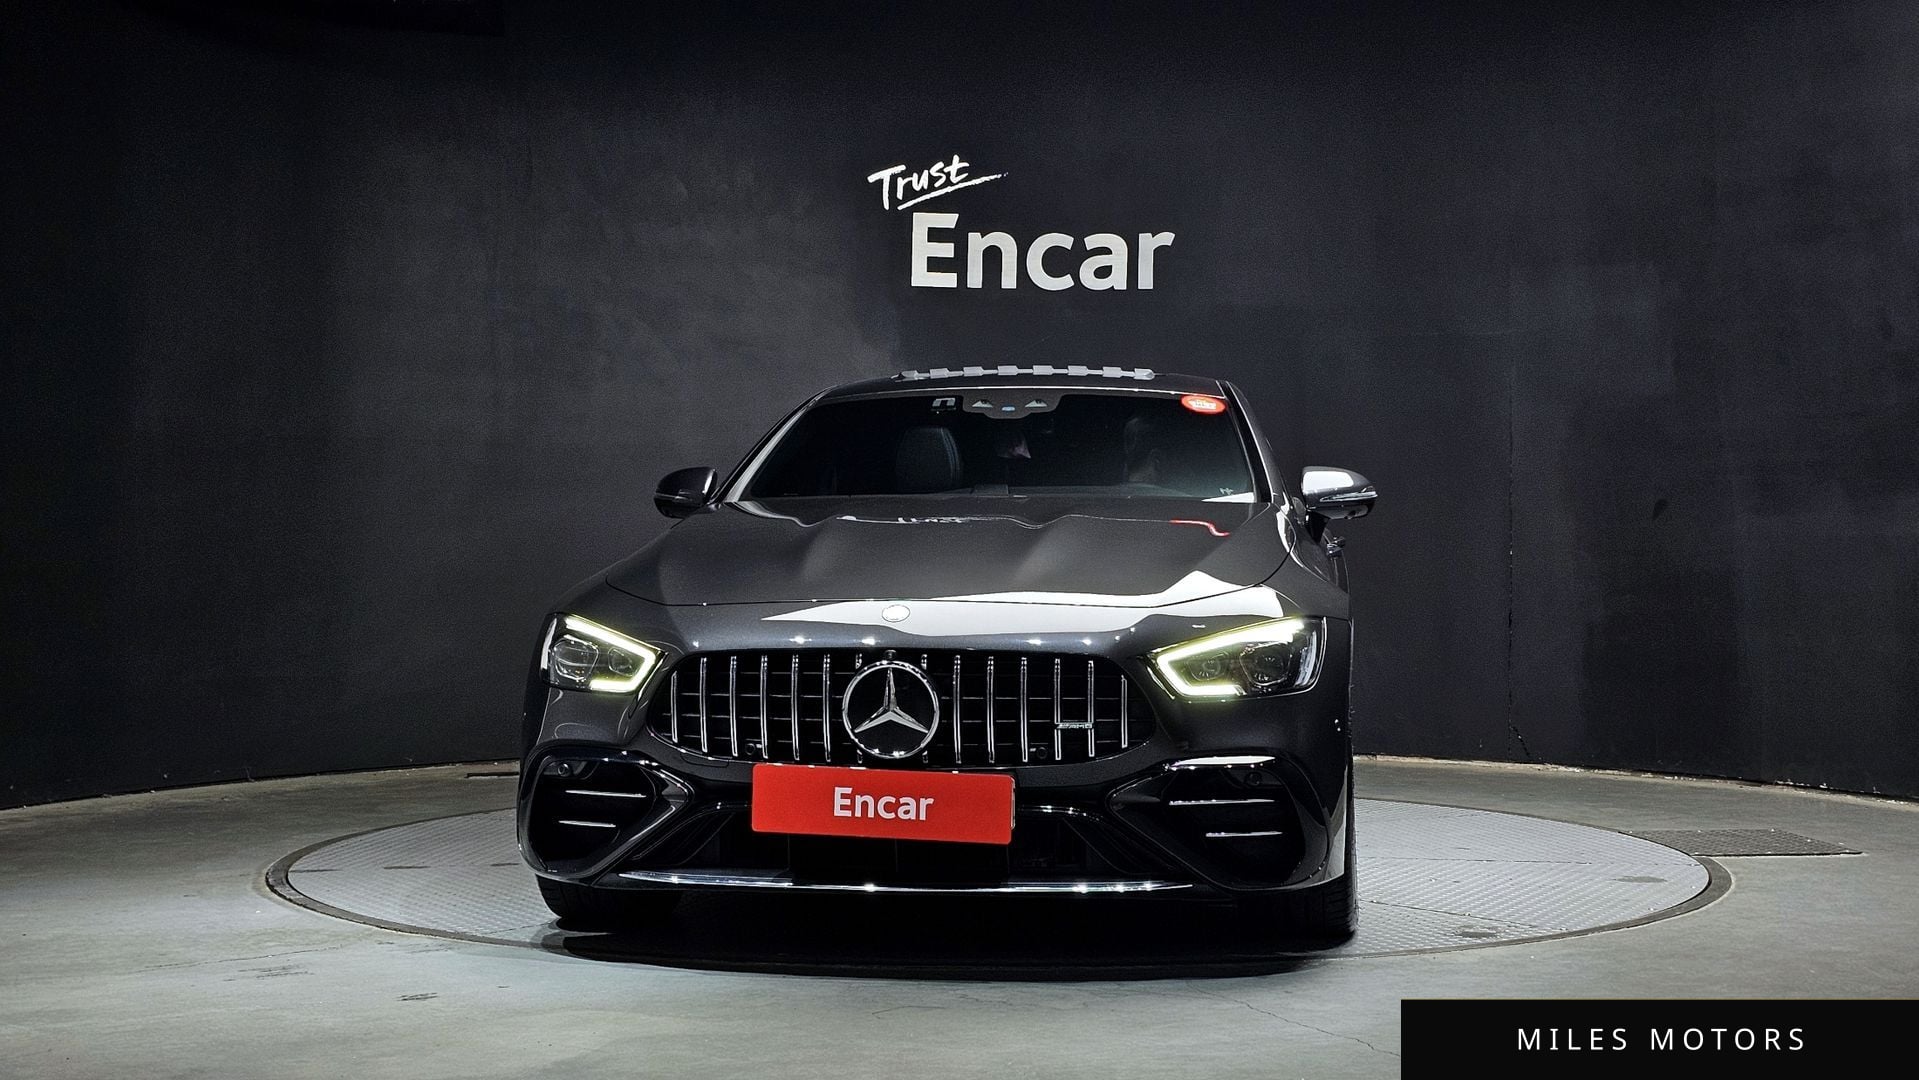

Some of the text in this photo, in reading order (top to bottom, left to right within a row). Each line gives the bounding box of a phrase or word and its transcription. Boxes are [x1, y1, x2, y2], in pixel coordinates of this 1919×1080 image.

[868, 154, 970, 211] Trust
[910, 212, 1176, 291] Encar
[833, 787, 934, 821] Encar
